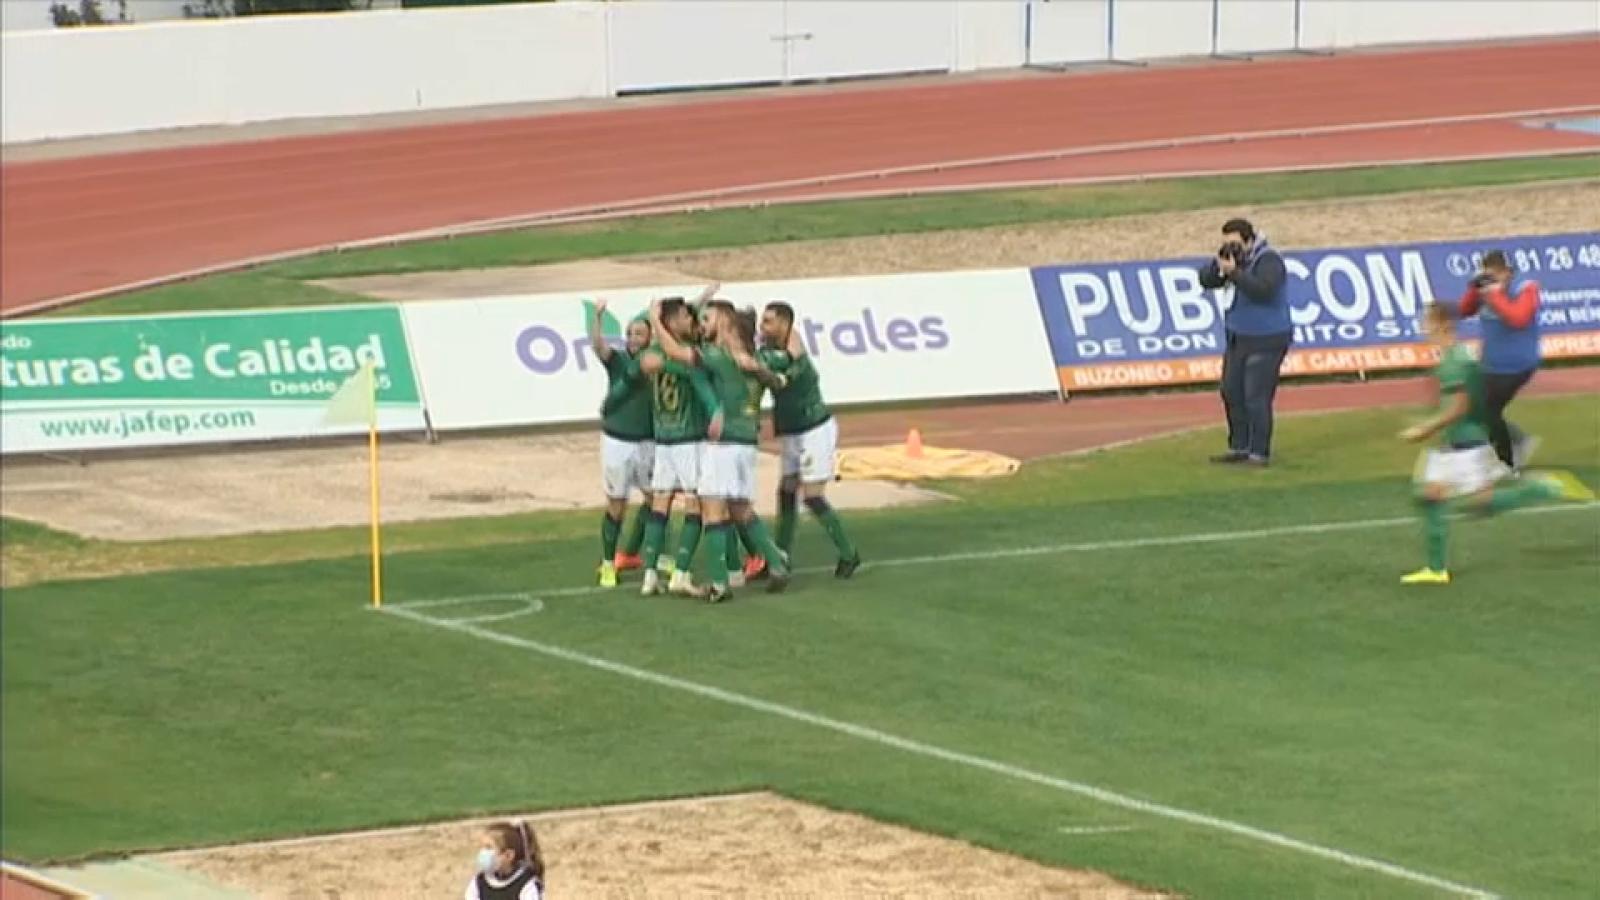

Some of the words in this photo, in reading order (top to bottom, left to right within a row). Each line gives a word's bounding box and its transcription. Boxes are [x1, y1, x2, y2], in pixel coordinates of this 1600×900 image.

[1514, 247, 1541, 273] 81
[1545, 245, 1574, 271] 26
[1058, 250, 1436, 337] PUBCOM
[134, 344, 195, 382] de
[204, 334, 387, 379] Calidad
[1075, 338, 1127, 357] DE
[1138, 333, 1218, 355] DON
[1073, 363, 1173, 386] BUZONEO
[1311, 347, 1417, 371] CARTELES
[269, 378, 338, 397] Desde
[39, 407, 256, 439] www.jafep.com
